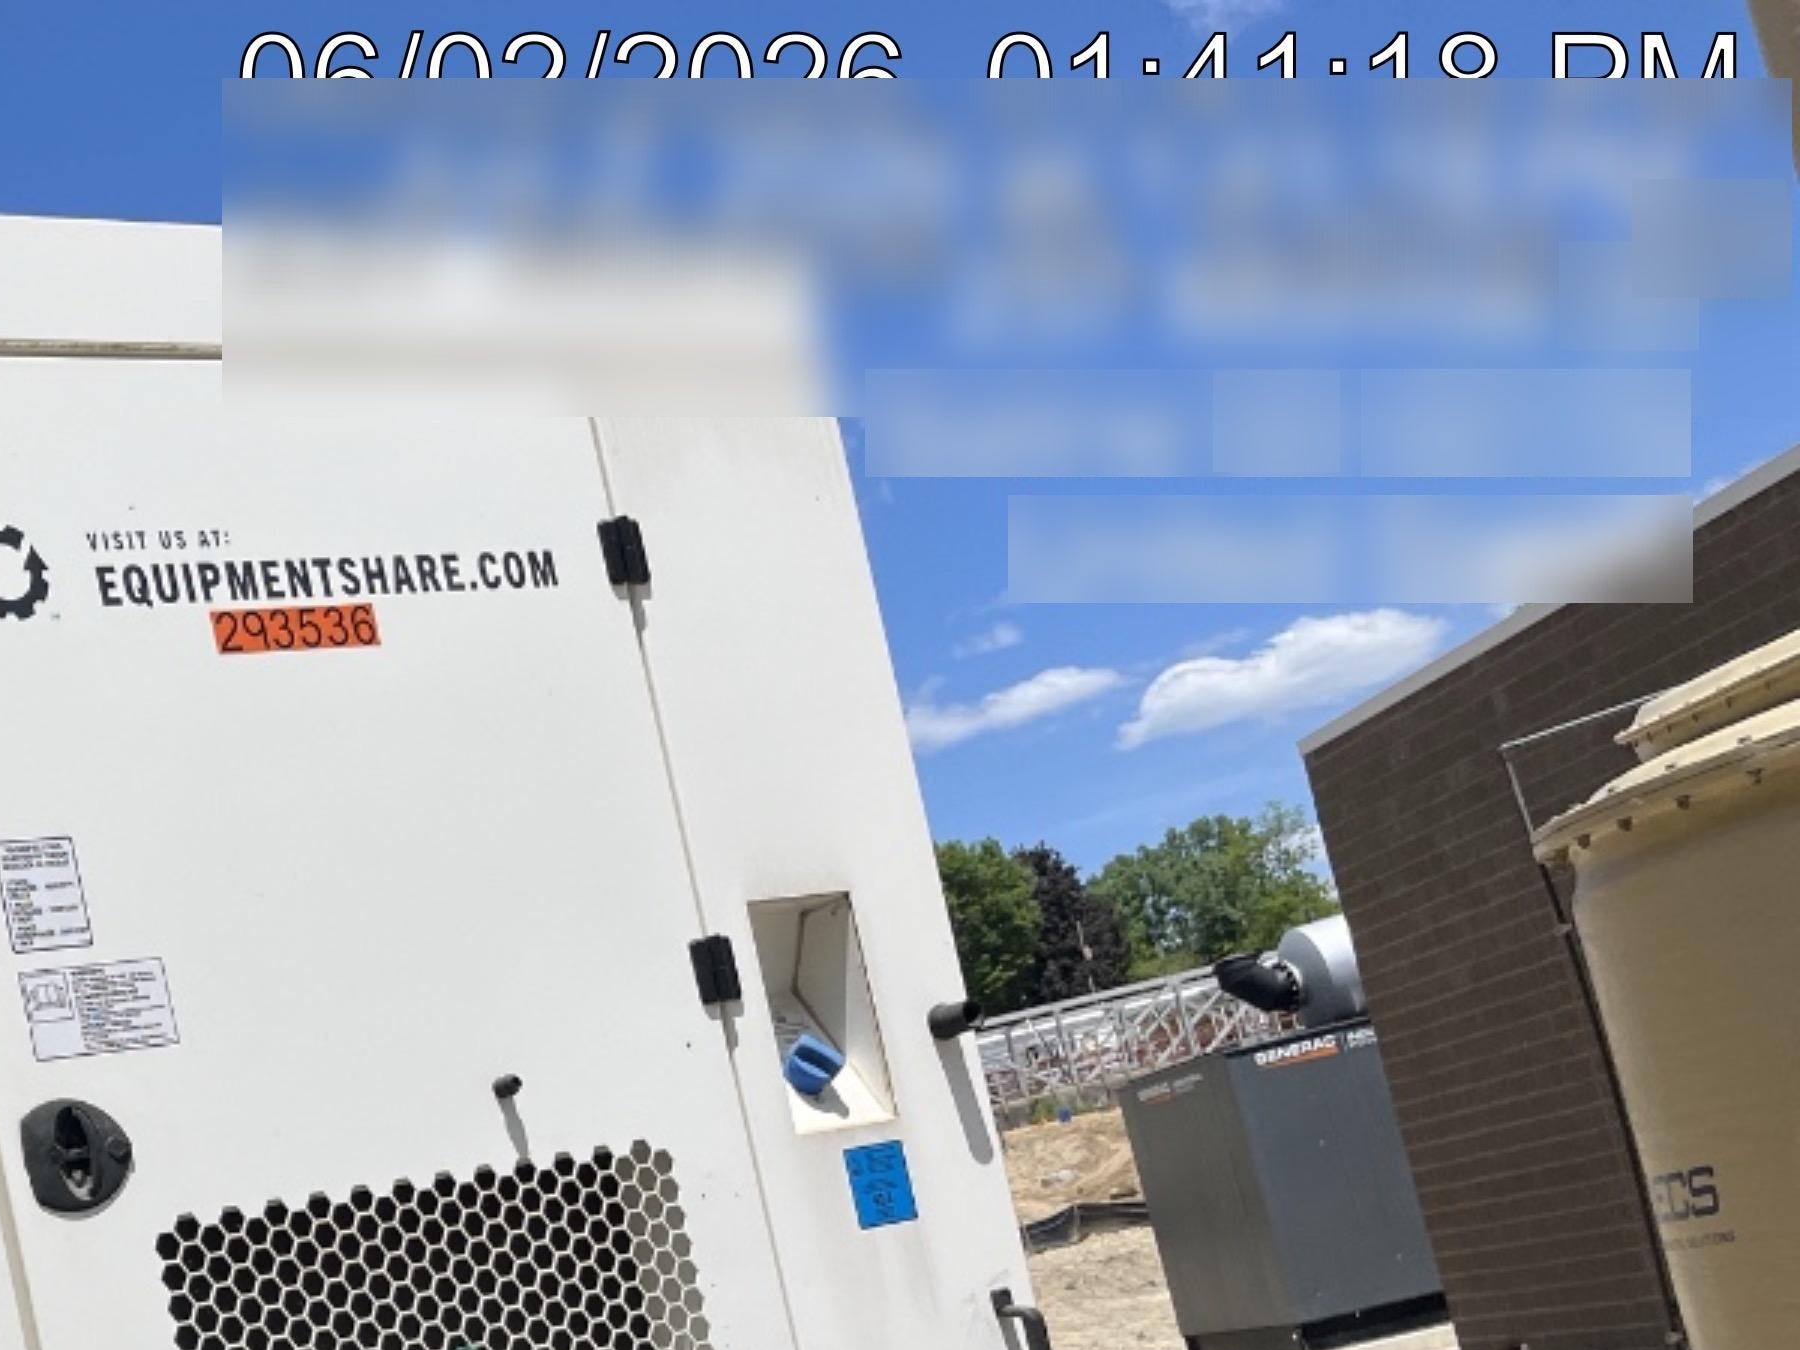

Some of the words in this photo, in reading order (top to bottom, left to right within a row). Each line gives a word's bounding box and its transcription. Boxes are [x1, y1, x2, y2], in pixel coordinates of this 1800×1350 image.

[85, 530, 147, 551] VISIT
[157, 530, 188, 550] US
[95, 548, 560, 608] EQUIPMENTSHARE.COM
[215, 605, 377, 652] 293536
